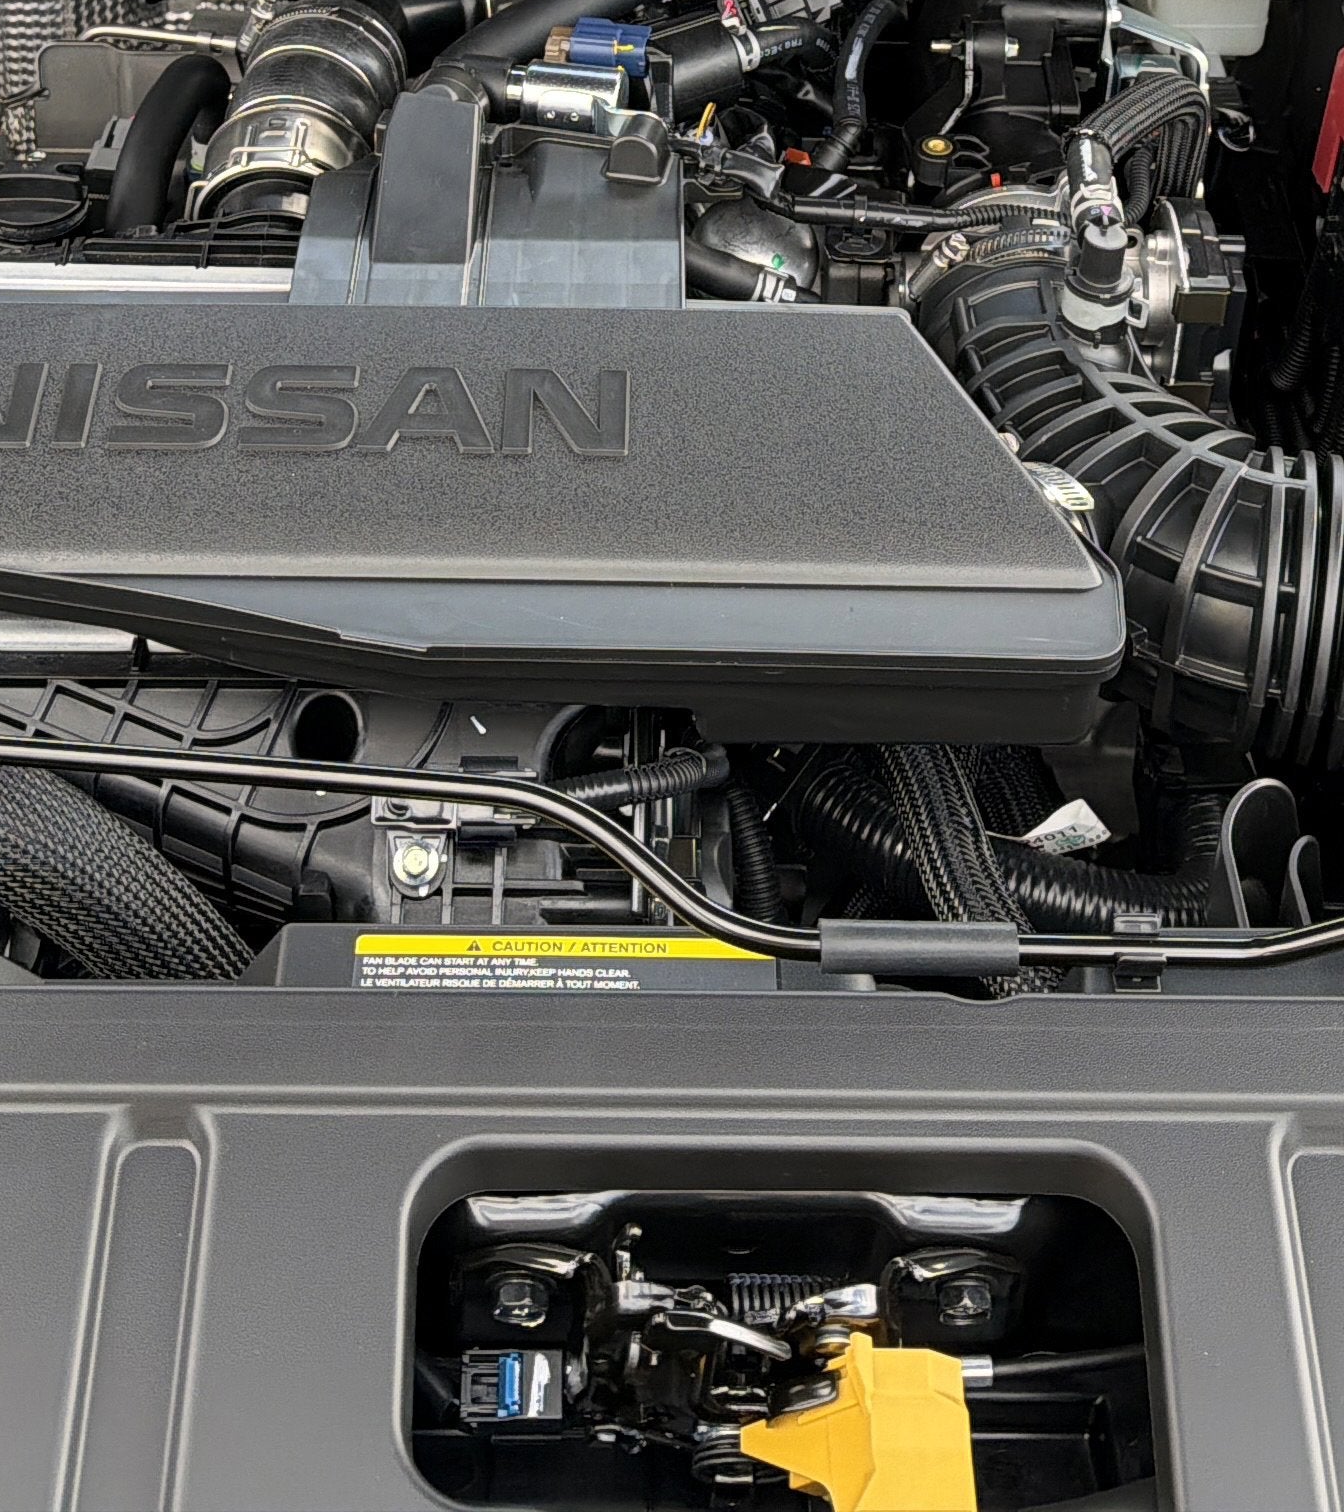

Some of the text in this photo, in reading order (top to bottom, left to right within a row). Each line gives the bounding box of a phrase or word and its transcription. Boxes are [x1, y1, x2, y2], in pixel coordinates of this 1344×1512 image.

[492, 940, 563, 952] CAUTION
[580, 942, 667, 954] ATTENTION
[362, 957, 539, 966] FAN BLADE CAN START AT ANY TIME.
[362, 967, 376, 975] TO
[378, 967, 405, 975] HELP
[406, 967, 437, 975] AVOID
[439, 967, 493, 976] PERSONAL
[557, 969, 593, 977] HANDS
[595, 969, 631, 977] CLEAR.
[375, 978, 440, 987] VENTILATEUR
[442, 979, 480, 987] RISQUE
[482, 979, 497, 987] DE
[498, 977, 554, 988] DÉMARRER
[565, 980, 592, 988] TOUT
[594, 980, 640, 989] MOMENT.
